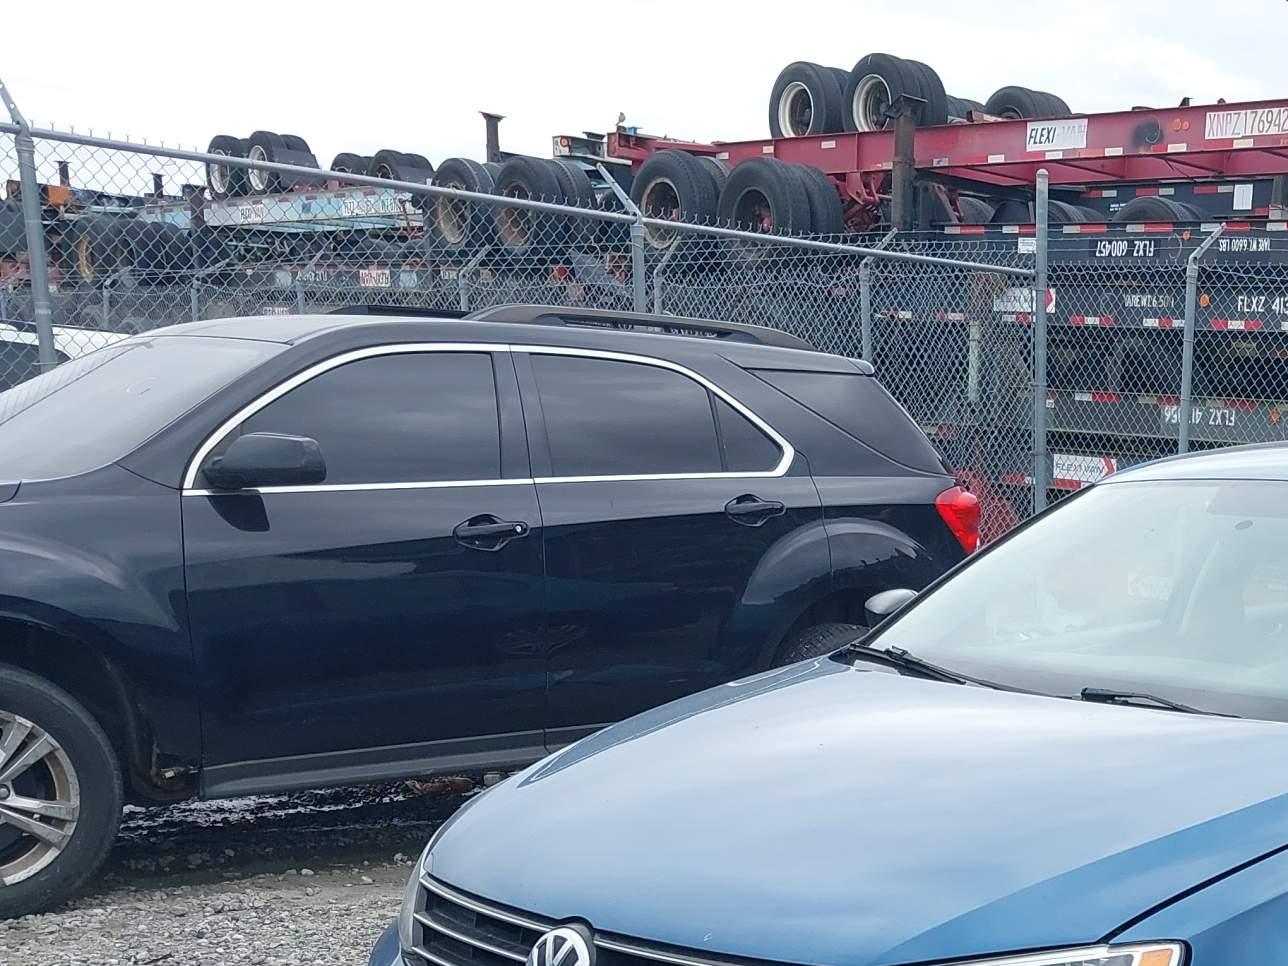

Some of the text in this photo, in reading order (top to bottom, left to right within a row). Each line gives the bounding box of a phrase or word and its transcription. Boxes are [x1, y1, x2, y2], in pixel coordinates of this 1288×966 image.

[1028, 126, 1056, 145] FLEXI
[1095, 240, 1154, 257] FLXZ 600457
[1237, 296, 1266, 313] FLXZ
[1208, 408, 1236, 426] FLXZ
